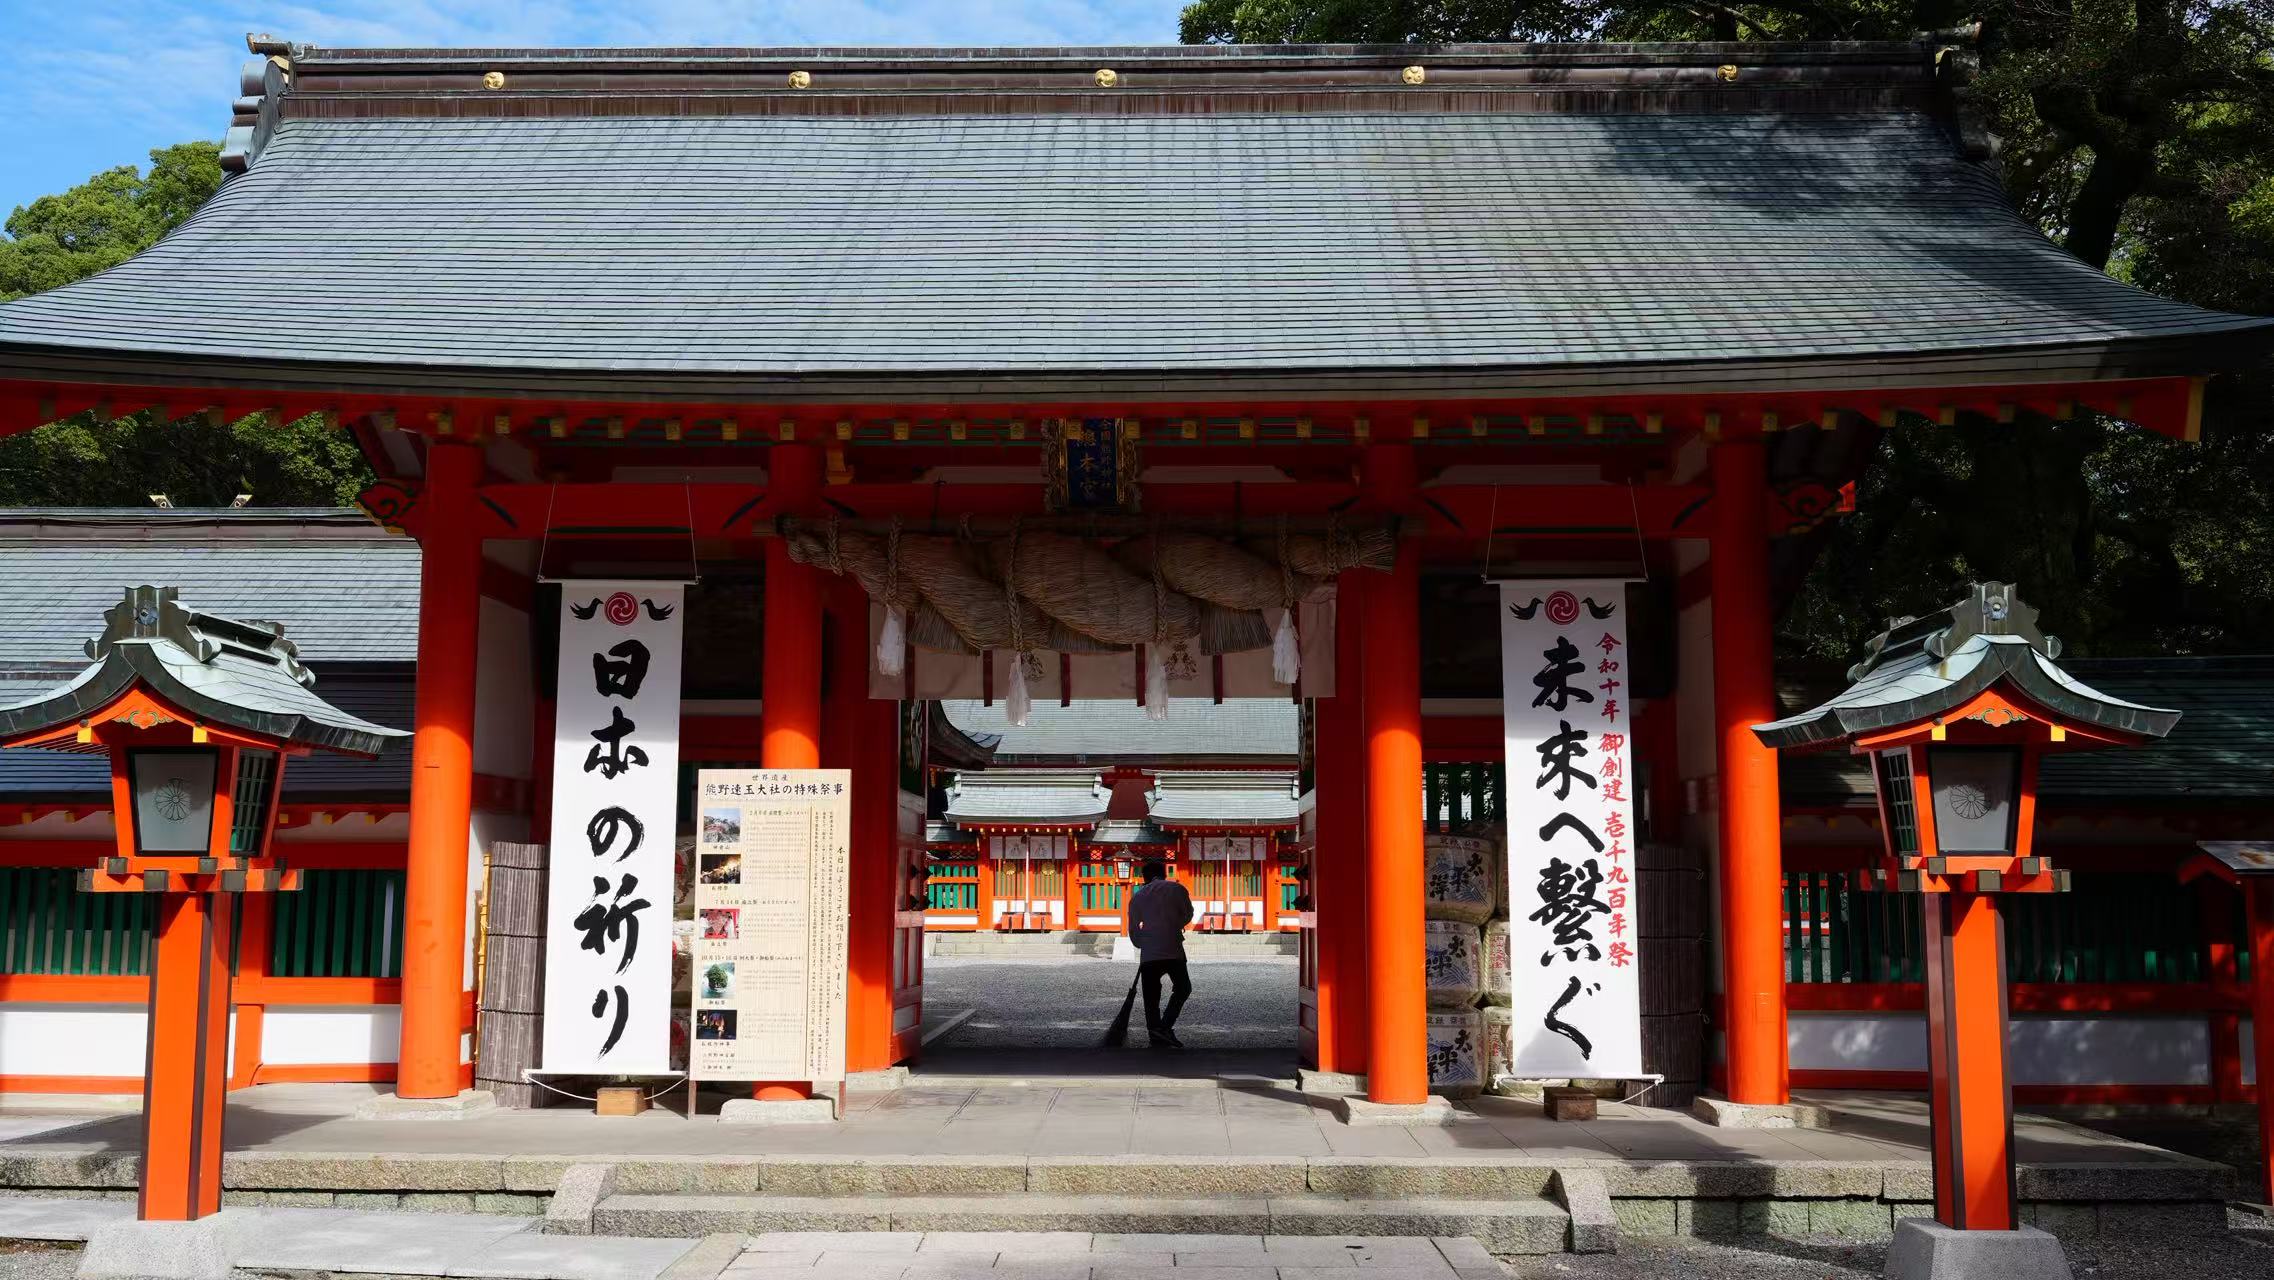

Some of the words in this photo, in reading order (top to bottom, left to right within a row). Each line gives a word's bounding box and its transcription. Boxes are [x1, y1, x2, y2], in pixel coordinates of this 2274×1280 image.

[1595, 632, 1622, 723] 令和十年
[705, 783, 844, 796] 熊野速玉大社の特殊祭事
[752, 774, 788, 782] 世界遺産
[1598, 732, 1626, 802] 御創建
[574, 639, 652, 1063] 日本の祈り
[1528, 636, 1612, 1061] 未来へ繋ぐ
[1604, 810, 1635, 969] 壱千九百年祭
